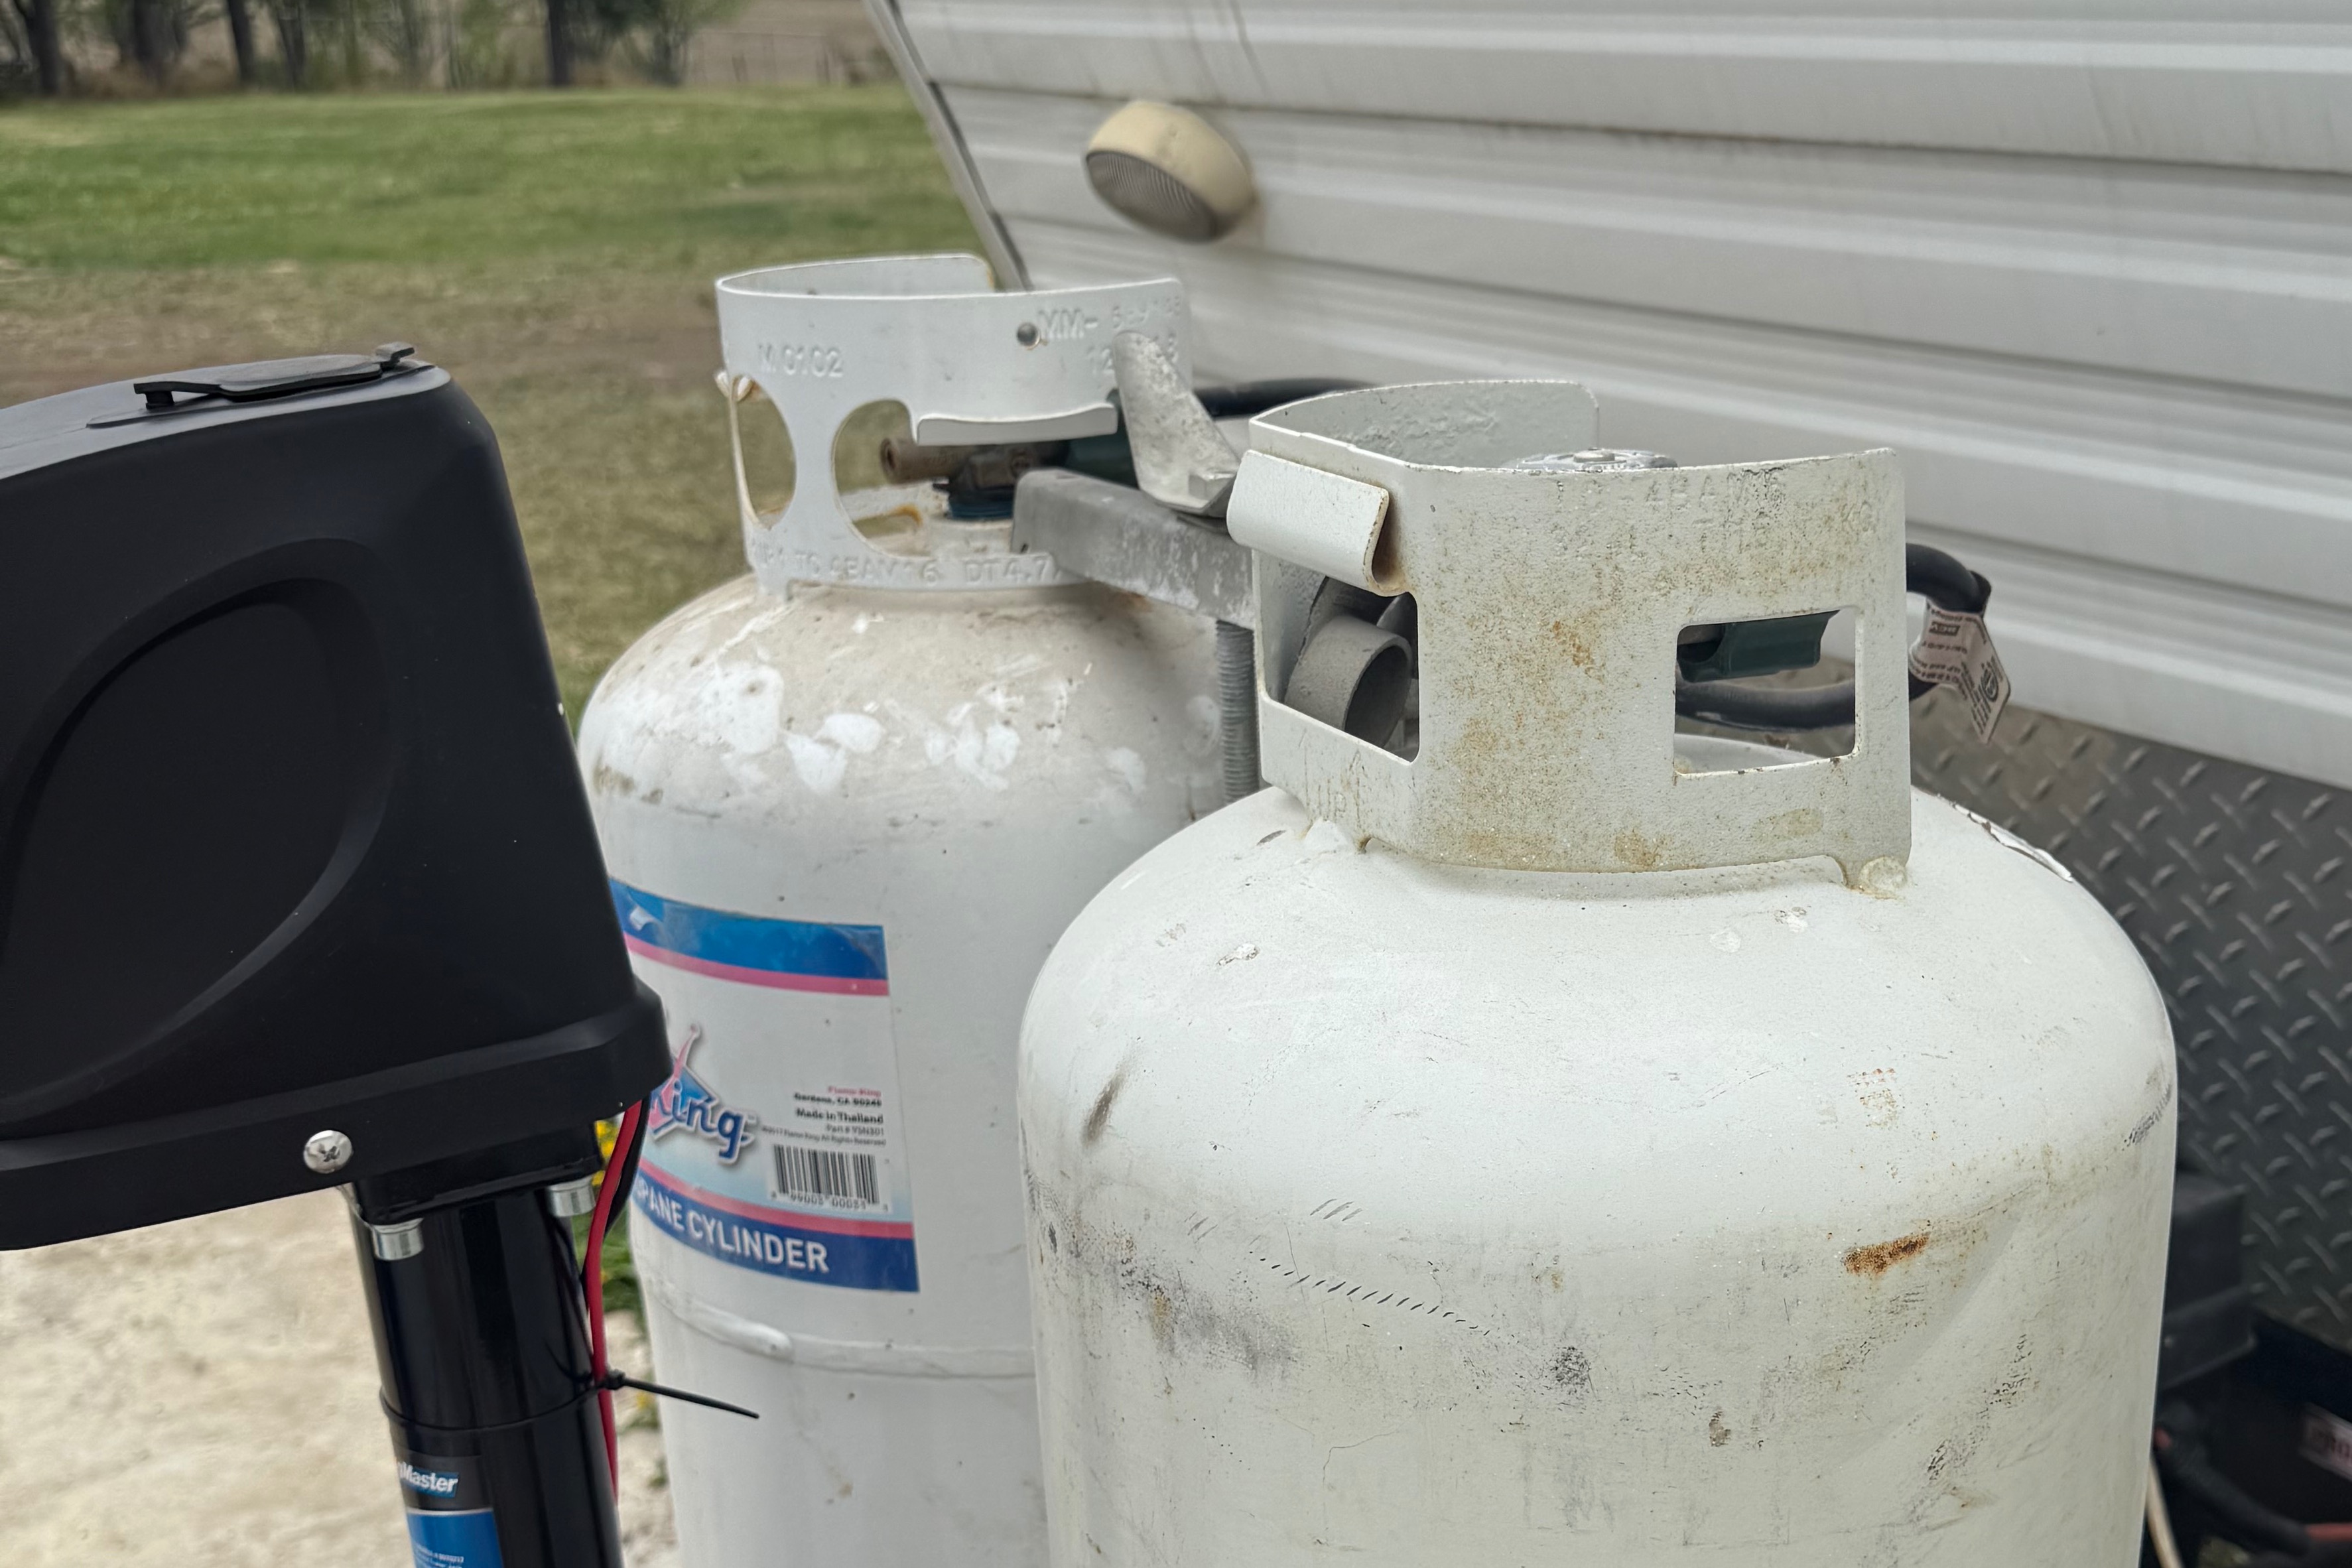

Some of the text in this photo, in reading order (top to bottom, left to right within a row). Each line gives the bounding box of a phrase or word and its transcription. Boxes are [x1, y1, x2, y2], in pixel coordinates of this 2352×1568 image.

[796, 1107, 824, 1120] Made
[837, 1111, 884, 1125] Thailand
[686, 1209, 830, 1274] CYLINDER
